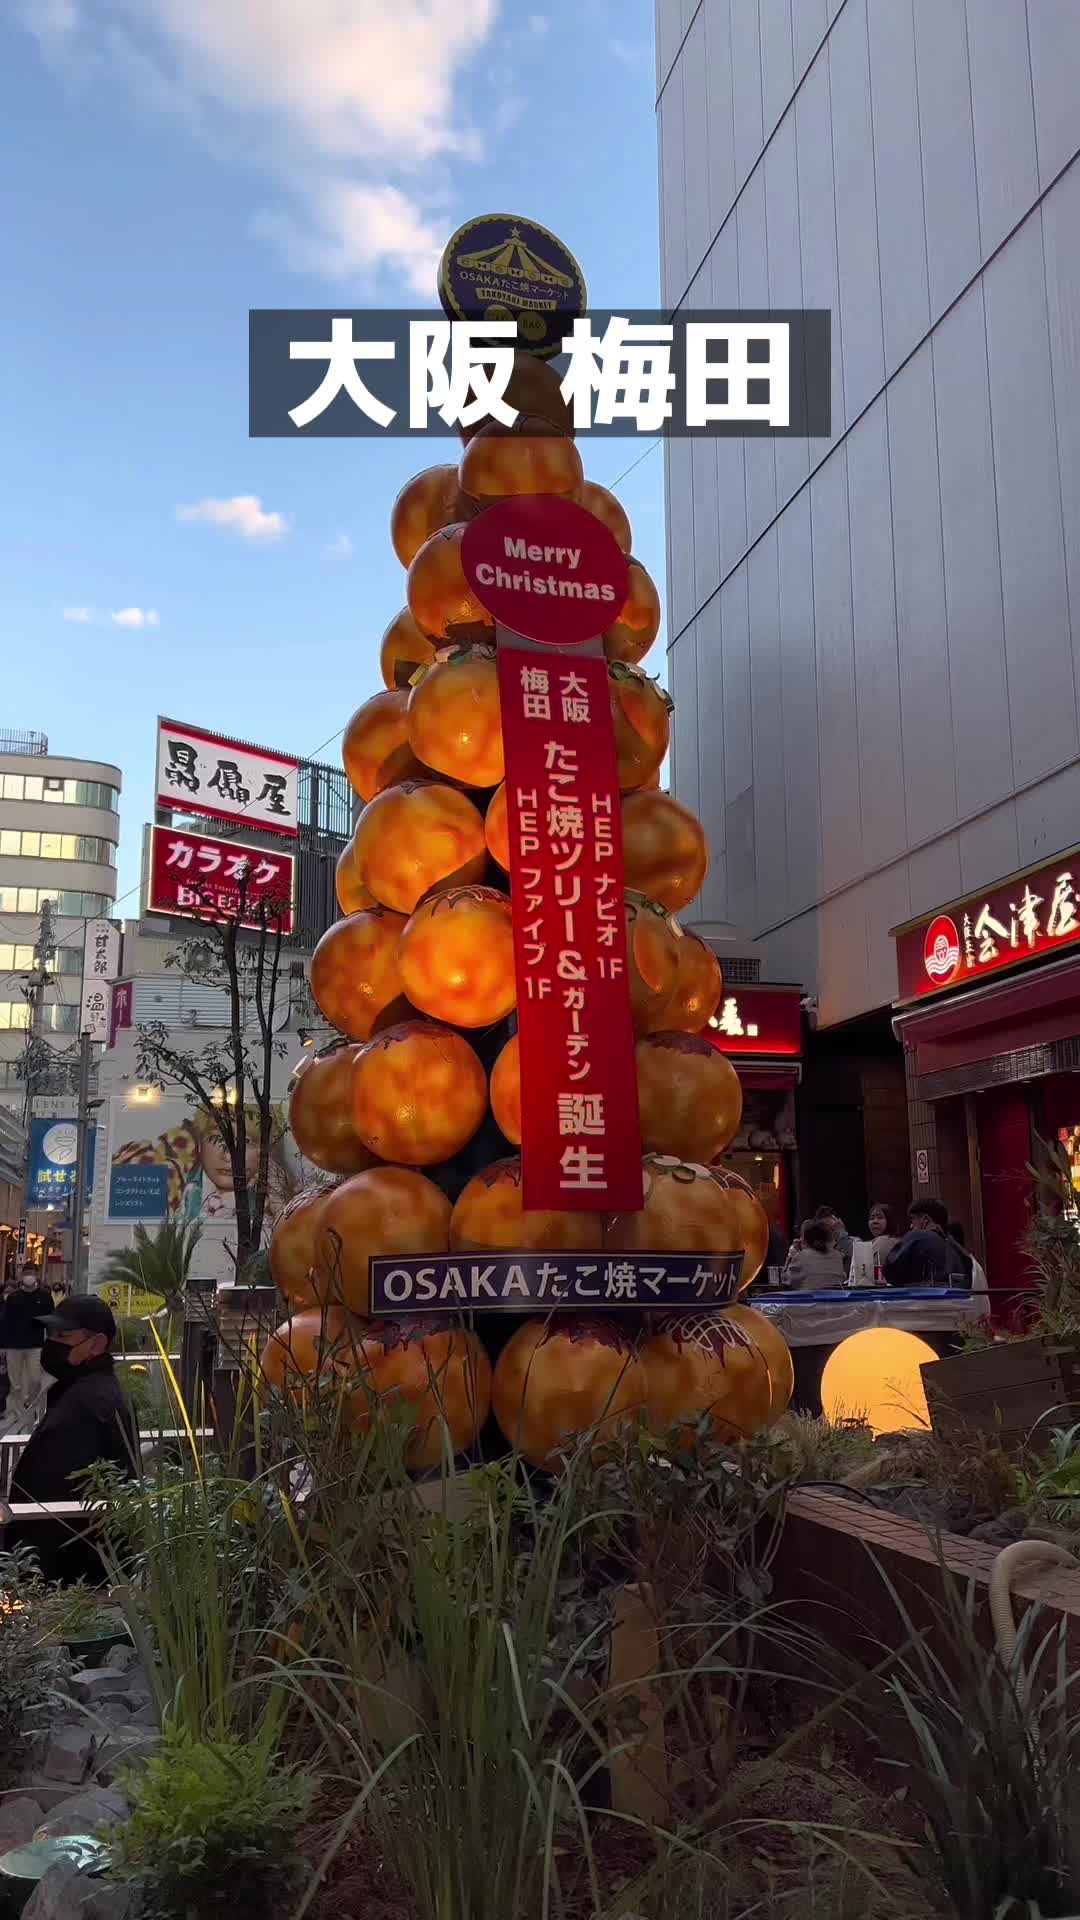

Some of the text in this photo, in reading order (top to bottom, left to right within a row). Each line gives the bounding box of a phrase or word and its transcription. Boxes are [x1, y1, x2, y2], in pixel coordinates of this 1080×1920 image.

[503, 536, 582, 569] Merry
[475, 563, 616, 602] Christmas
[520, 665, 552, 721] 梅田
[559, 671, 592, 723] 大阪
[165, 840, 280, 885] カラオケ
[591, 792, 624, 980] HEP ナビオ 1F
[516, 787, 552, 1000] HEP ファイブ 1F
[383, 1261, 737, 1302] OSAKAたこ焼マーケット
